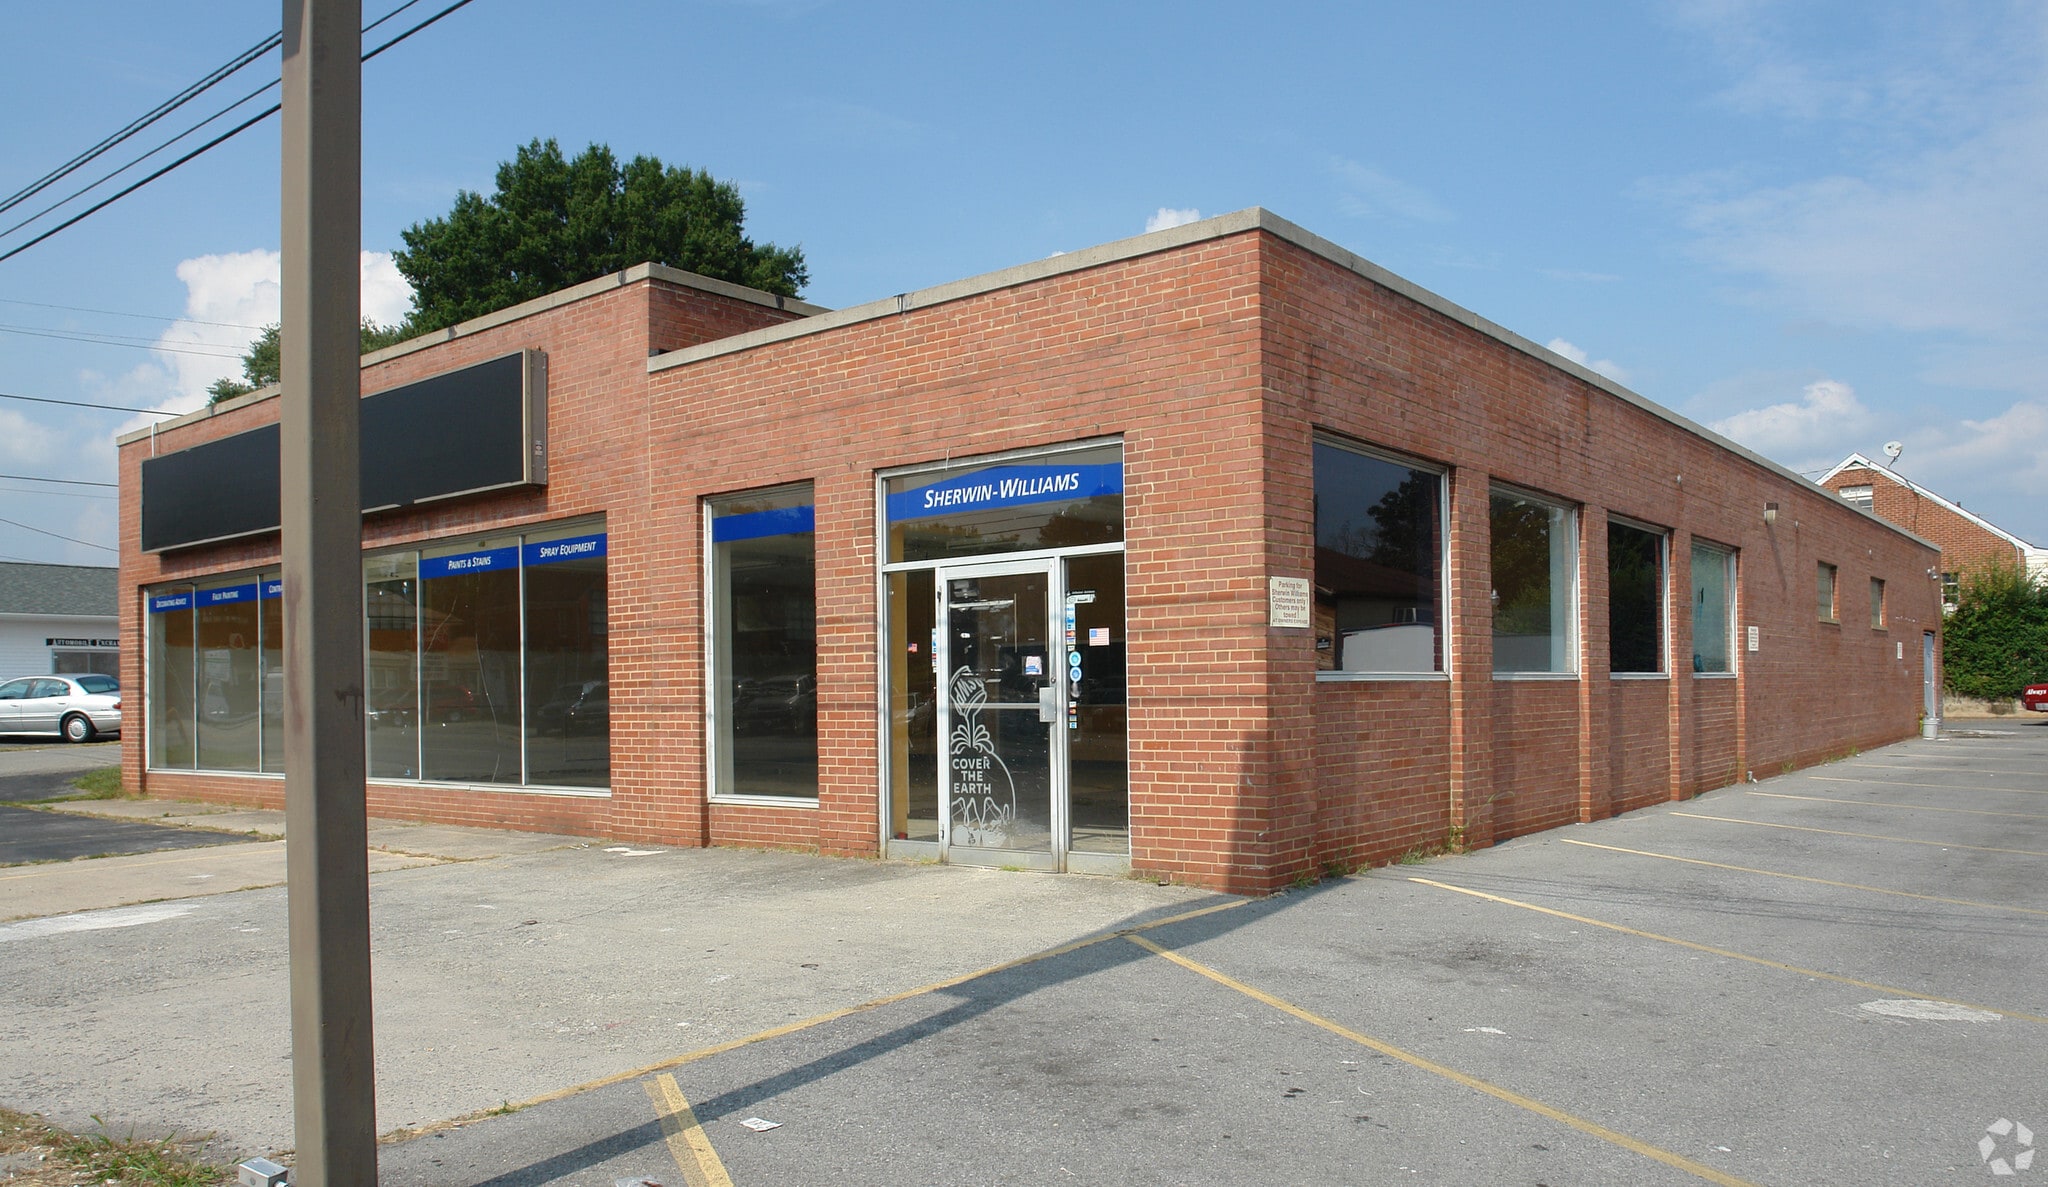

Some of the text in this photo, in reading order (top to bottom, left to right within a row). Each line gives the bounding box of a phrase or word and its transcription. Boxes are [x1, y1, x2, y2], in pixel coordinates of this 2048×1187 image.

[924, 473, 1079, 508] SHERWIN-WILLIAMS
[540, 541, 597, 558] SPRAY EQUIPMENT
[448, 556, 491, 570] PAINTS & STAINS
[1278, 580, 1295, 589] Parking
[51, 638, 92, 647] AUTOMOBILE
[2025, 688, 2047, 696] Always
[952, 758, 990, 770] COVER
[960, 770, 983, 782] THE
[953, 783, 991, 794] EARTH
